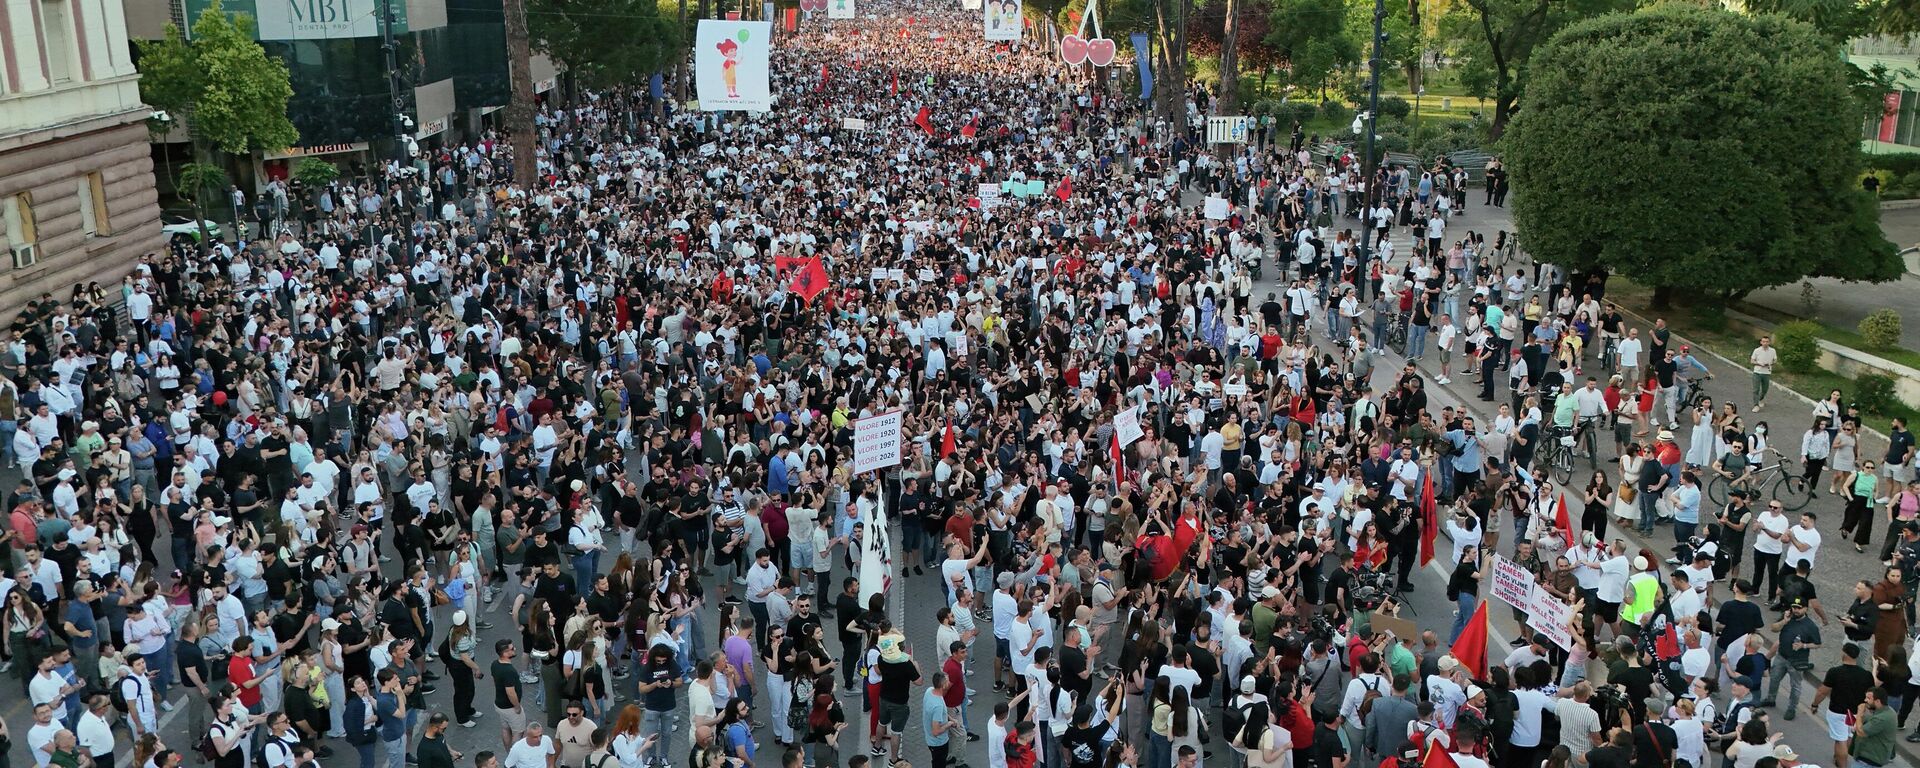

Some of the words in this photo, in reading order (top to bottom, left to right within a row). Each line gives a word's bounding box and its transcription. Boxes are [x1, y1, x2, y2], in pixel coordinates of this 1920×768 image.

[880, 417, 896, 427] 1912
[880, 428, 896, 438] 1920
[880, 440, 895, 450] 1997
[879, 451, 895, 461] 2026
